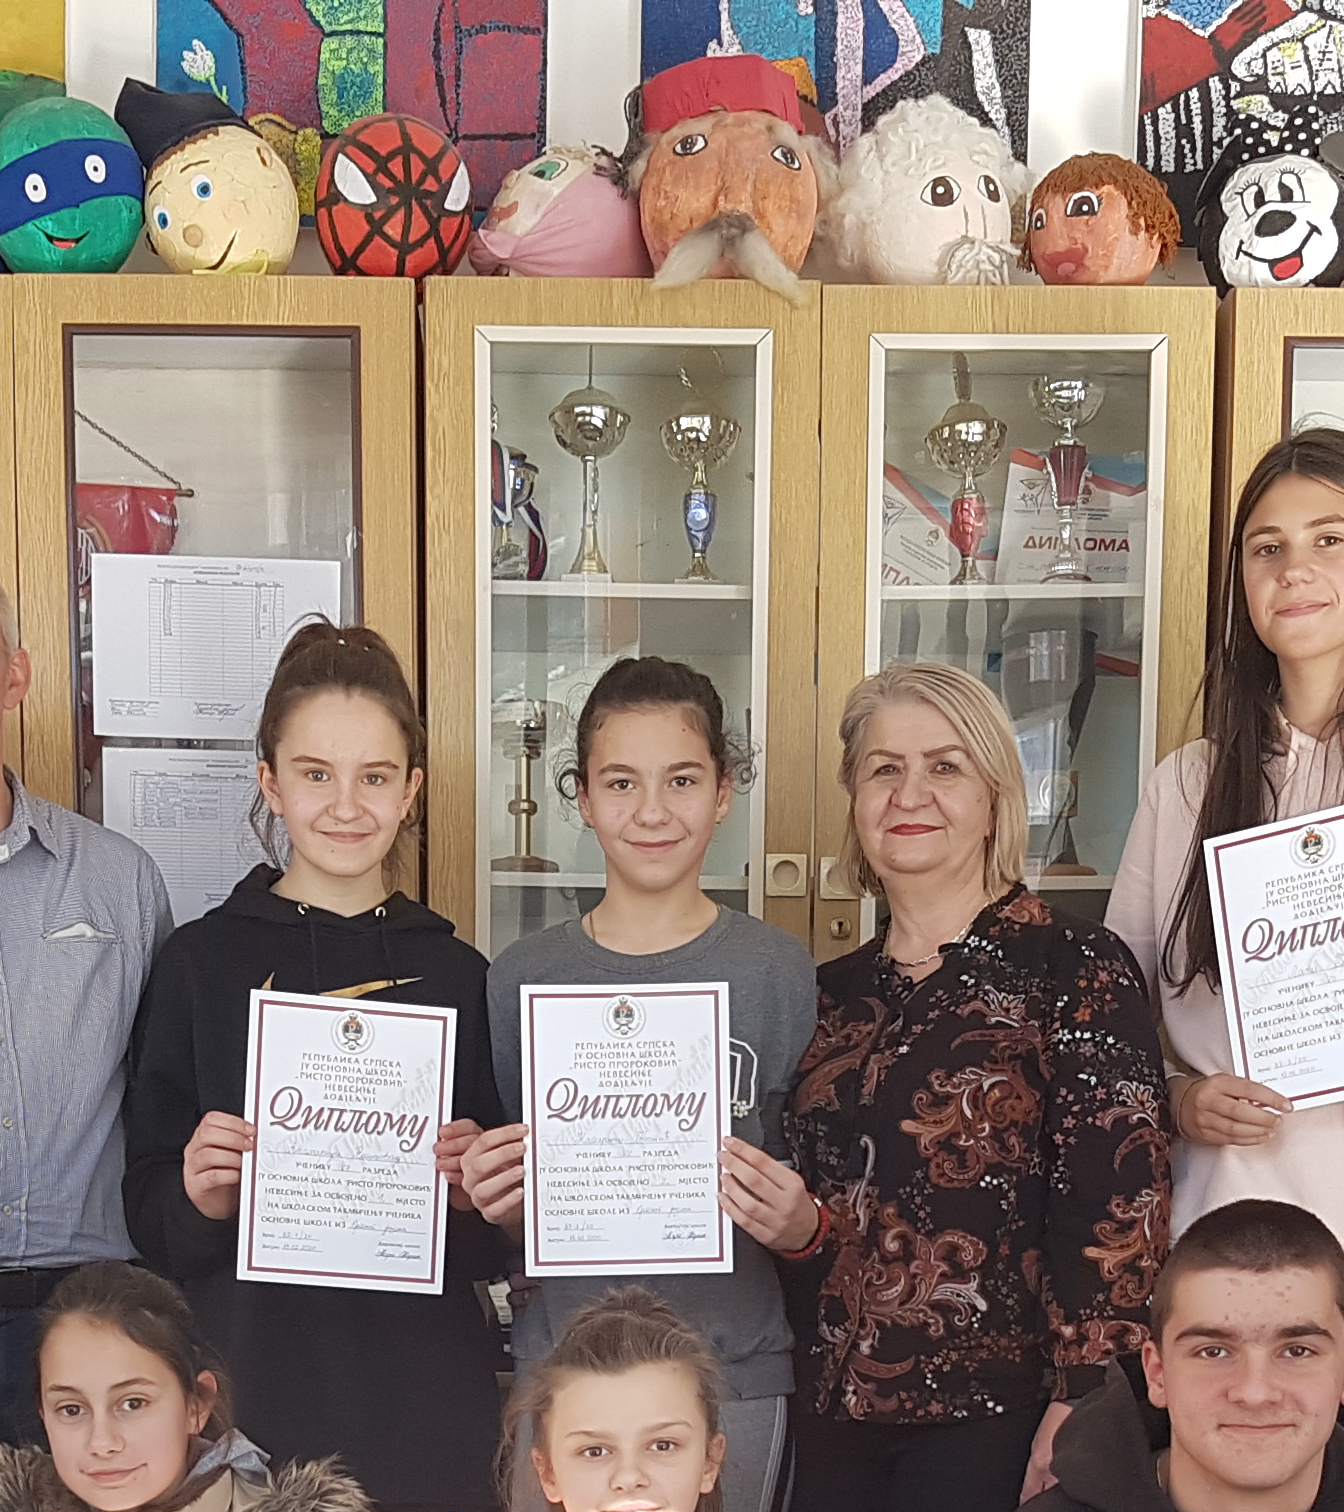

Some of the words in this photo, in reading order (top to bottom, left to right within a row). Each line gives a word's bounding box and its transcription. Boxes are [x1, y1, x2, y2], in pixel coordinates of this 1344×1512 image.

[1264, 867, 1325, 889] РЕПУБЛИКА
[1276, 875, 1330, 896] ОСНОВНА
[1276, 979, 1315, 995] УЧЕНИКУ
[1250, 999, 1295, 1016] ОСНОВНА
[1295, 991, 1329, 1006] ШКОЛА
[1251, 1012, 1297, 1031] НЕВЕСИЊЕ
[1298, 1010, 1311, 1020] ЗА
[1256, 1034, 1270, 1044] НА
[1270, 1022, 1323, 1040] ШКОЛСКОМ
[574, 1040, 633, 1050] РЕПУБЛИКА
[634, 1039, 676, 1049] СРПСКА
[1252, 1042, 1294, 1059] ОСНОВНЕ
[1295, 1035, 1327, 1049] ШКОЛЕ
[301, 1051, 361, 1065] РЕПУБЛИКА
[361, 1057, 402, 1069] СРПСКА
[584, 1050, 637, 1060] ОСНОВНА
[638, 1048, 676, 1059] ШКОЛА
[311, 1061, 363, 1075] ОСНОВНА
[364, 1066, 402, 1079] ШКОЛА
[598, 1068, 652, 1079] НЕВЕСИЊЕ
[323, 1082, 377, 1095] НЕВЕСИЊЕ
[597, 1078, 653, 1088] ДОДЈЕЉУЈЕ
[322, 1091, 376, 1105] ДОДЈЕЉУЈЕ
[545, 1077, 706, 1132] Диплому
[269, 1085, 429, 1153] Диплому
[574, 1150, 612, 1159] УЧЕНИКУ
[641, 1148, 680, 1157] РАЗРЕДА
[294, 1160, 331, 1171] УЧЕНИКУ
[361, 1165, 399, 1177] РАЗРЕДА
[547, 1164, 591, 1174] ОСНОВНА
[591, 1164, 624, 1173] ШКОЛА
[266, 1172, 309, 1183] ОСНОВНА
[310, 1176, 342, 1186] ШКОЛА
[545, 1178, 591, 1188] НЕВЕСИЊЕ
[593, 1178, 604, 1187] ЗА
[604, 1177, 650, 1187] ОСВОЈЕНО
[677, 1175, 709, 1186] МЈЕСТО
[263, 1186, 308, 1198] НЕВЕСИЊЕ
[310, 1189, 322, 1198] ЗА
[322, 1190, 368, 1202] ОСВОЈЕНО
[394, 1196, 426, 1206] МЈЕСТО
[549, 1194, 563, 1202] НА
[563, 1193, 614, 1202] ШКОЛСКОМ
[667, 1190, 706, 1199] УЧЕНИКА
[266, 1200, 280, 1210] НА
[280, 1202, 331, 1213] ШКОЛСКОМ
[383, 1209, 422, 1220] УЧЕНИКА
[543, 1207, 585, 1217] ОСНОВНЕ
[586, 1206, 617, 1216] ШКОЛЕ
[259, 1214, 301, 1225] ОСНОВНЕ
[302, 1218, 332, 1228] ШКОЛЕ
